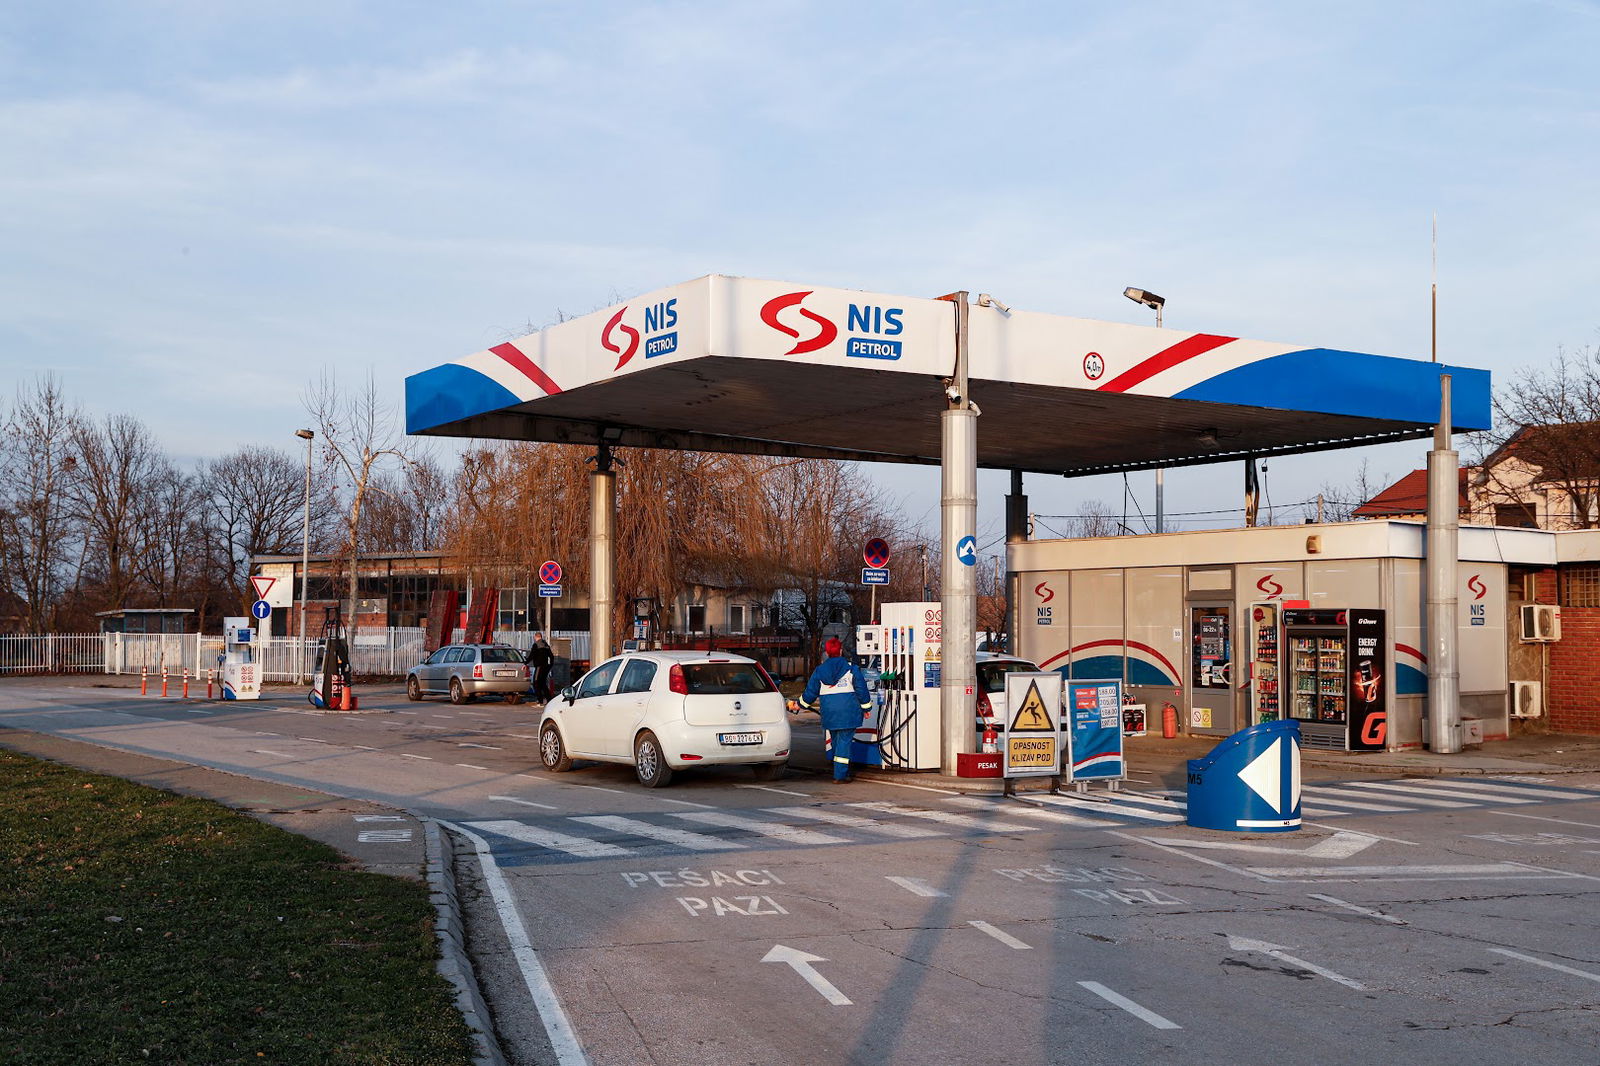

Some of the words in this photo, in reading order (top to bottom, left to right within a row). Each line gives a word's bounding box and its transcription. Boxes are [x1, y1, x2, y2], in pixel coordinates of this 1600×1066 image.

[645, 298, 677, 334] NIS
[847, 304, 903, 335] NIS
[648, 338, 675, 354] PETROL
[852, 342, 897, 356] PETROL
[1037, 607, 1052, 616] NIS
[1471, 604, 1485, 615] NIS
[1358, 638, 1377, 647] ENERGY
[1358, 647, 1375, 656] DRINK
[1013, 741, 1050, 750] OPASNOST
[1011, 753, 1035, 762] KLIZAV
[1036, 753, 1051, 762] POD
[1187, 773, 1203, 785] M5
[620, 867, 786, 888] PEŠACI
[675, 895, 790, 917] PAZI
